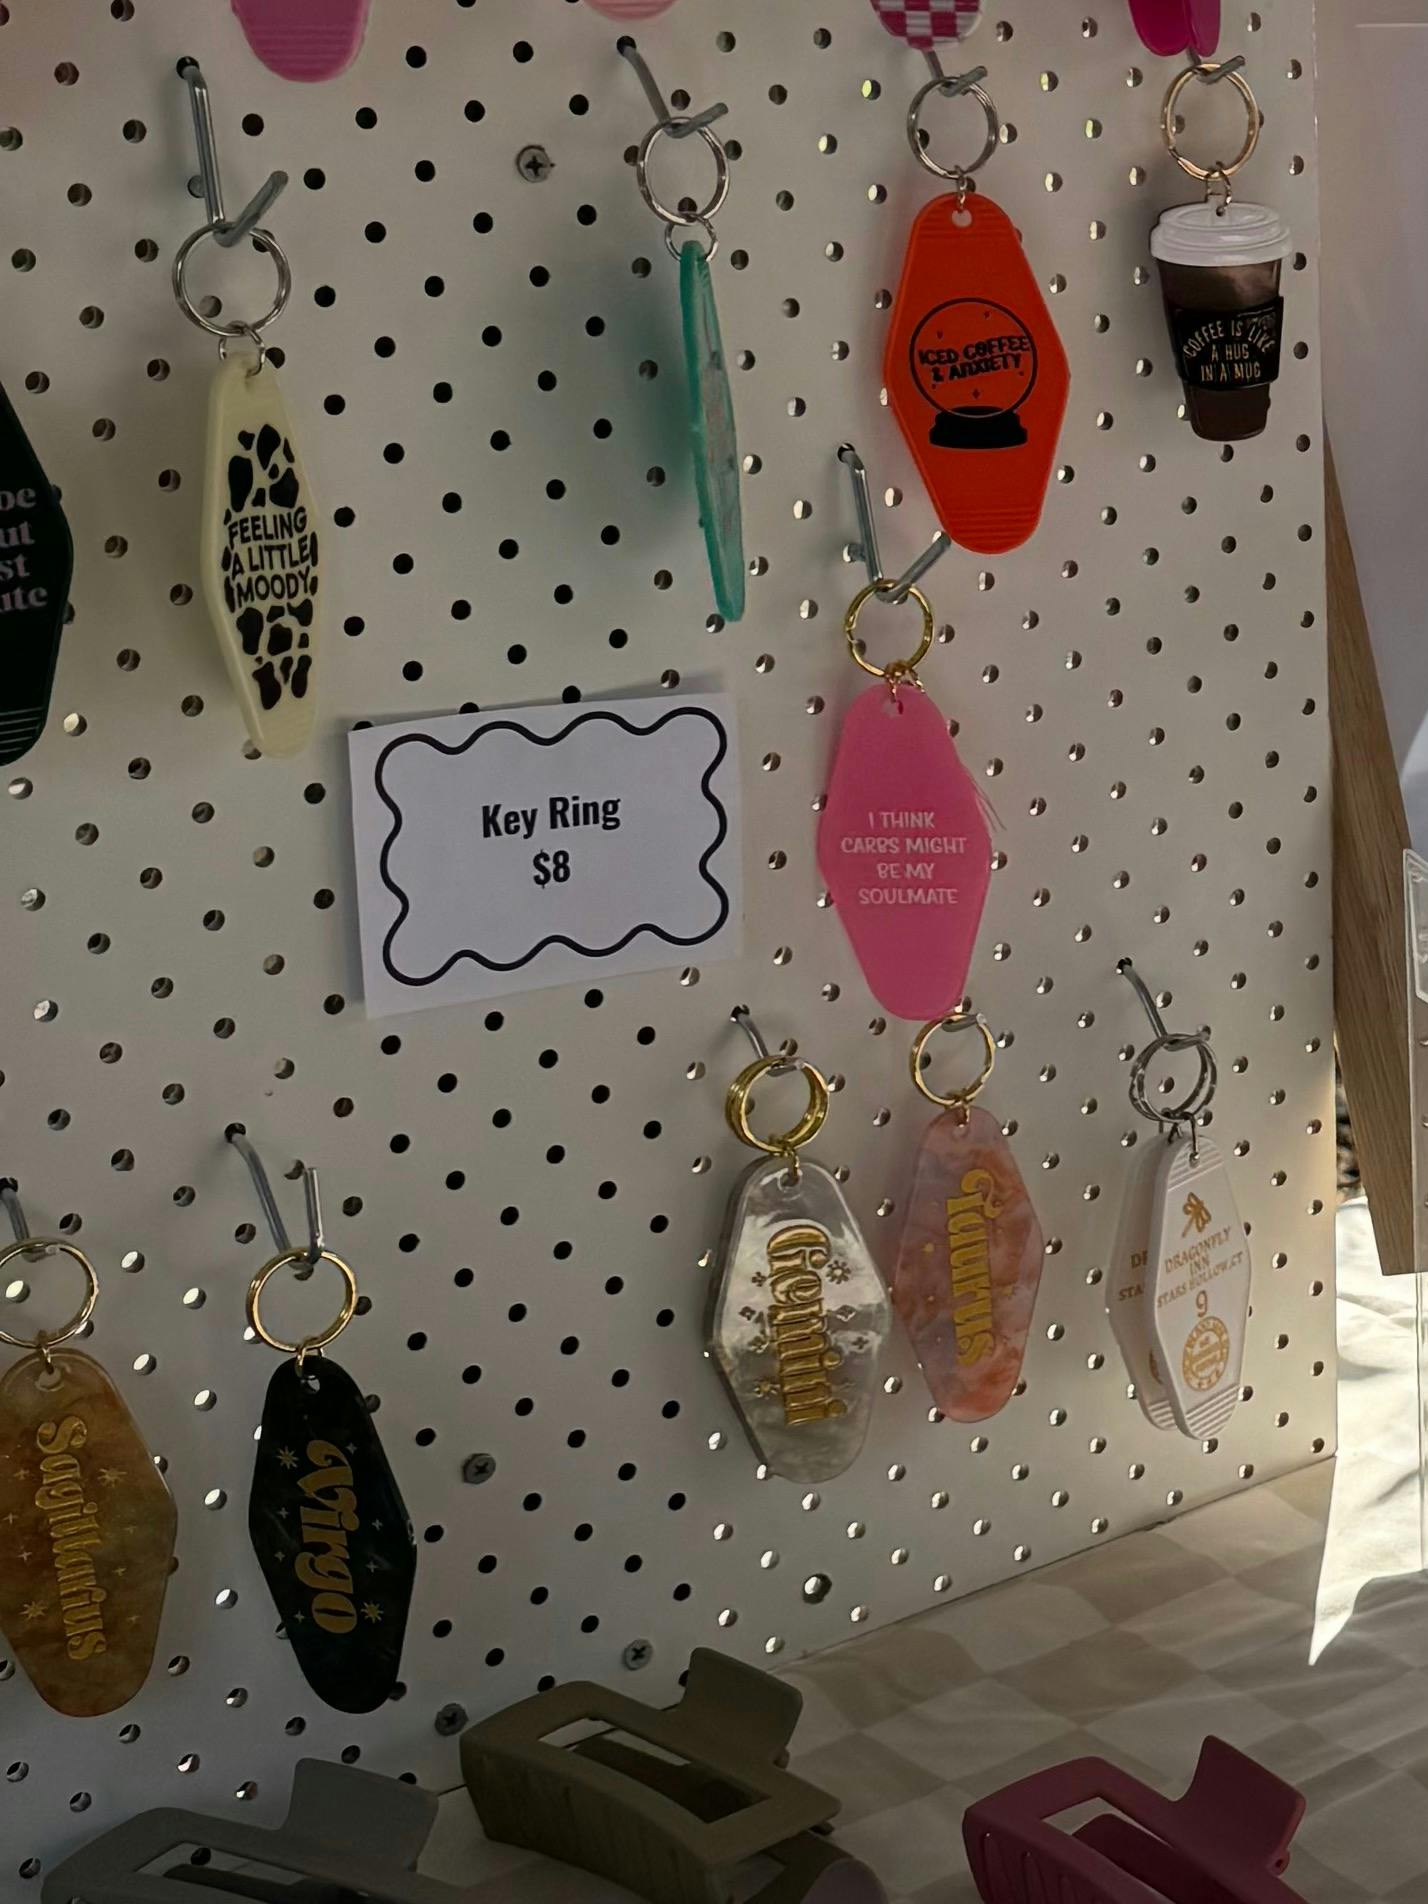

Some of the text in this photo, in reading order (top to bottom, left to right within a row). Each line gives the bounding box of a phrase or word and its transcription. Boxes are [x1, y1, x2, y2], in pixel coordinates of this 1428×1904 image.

[919, 336, 1030, 365] ICED COFFEE
[1183, 320, 1243, 358] COFFEE IS
[1225, 344, 1249, 360] HUG
[1200, 362, 1260, 381] IN MUG
[227, 506, 309, 546] FEELING
[248, 538, 312, 573] LITTLE
[235, 572, 311, 606] MOODY
[481, 795, 622, 840] Key Ring
[880, 812, 935, 829] THINK
[841, 837, 967, 854] CARBS MIGHT
[532, 849, 571, 887] $8
[876, 863, 935, 879] BE MY
[858, 888, 959, 905] SOULMATE
[945, 1168, 998, 1366] Taurus
[1164, 1226, 1231, 1273] DRAGONFLY
[1195, 1290, 1208, 1317] 9
[766, 1224, 846, 1425] Gemini
[35, 1414, 107, 1661] Sagittarius
[295, 1439, 358, 1634] Virgo
